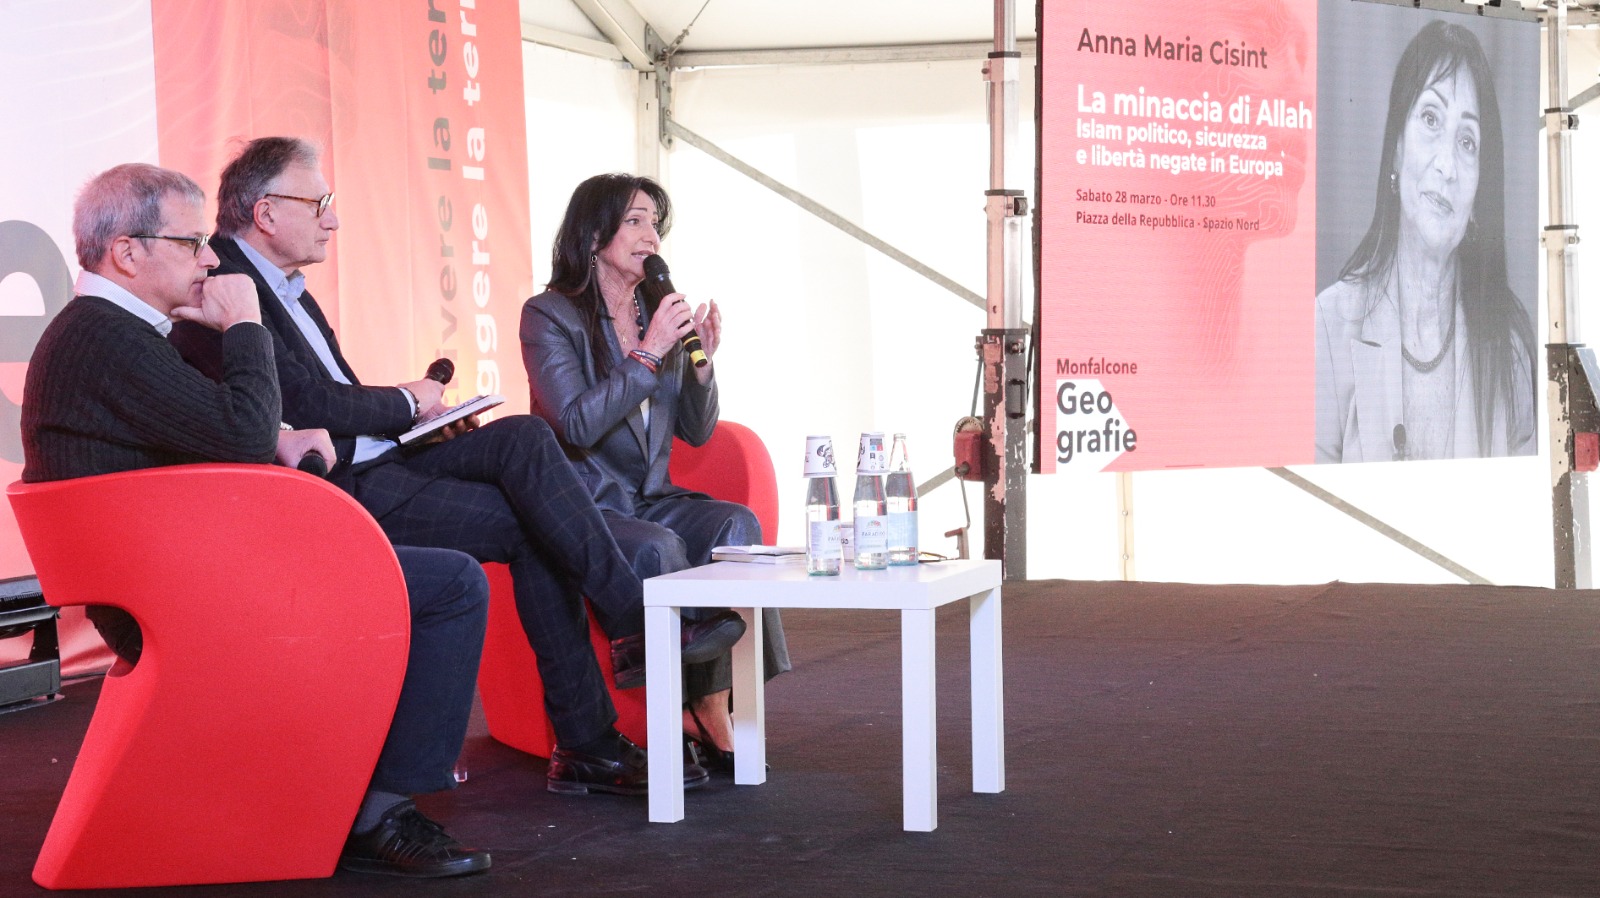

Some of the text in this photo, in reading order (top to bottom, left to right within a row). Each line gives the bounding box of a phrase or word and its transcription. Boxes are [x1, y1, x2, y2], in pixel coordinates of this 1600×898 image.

[1077, 28, 1268, 69] Anna Maria Cisint
[1077, 84, 1313, 129] La minaccia di Allah
[428, 117, 452, 171] la
[1076, 118, 1267, 150] Islam politico, sicurezza
[463, 127, 485, 181] la
[1076, 149, 1087, 165] e
[1091, 145, 1146, 168] libertà
[1150, 153, 1207, 175] negate
[1210, 152, 1225, 173] in
[1076, 189, 1113, 203] Sabato
[1115, 191, 1127, 203] 28
[1130, 194, 1161, 205] marzo
[1170, 194, 1188, 206] Ore
[1191, 195, 1216, 207] 11.30
[1076, 211, 1109, 225] Piazza
[1111, 213, 1137, 226] della
[1139, 214, 1195, 230] Repubblica
[1203, 217, 1234, 232] Spazio
[1236, 218, 1260, 231] Nord
[435, 195, 459, 408] ivere
[1056, 357, 1138, 375] Monfalcone
[1056, 382, 1113, 415] Geo
[1056, 418, 1138, 464] grafie
